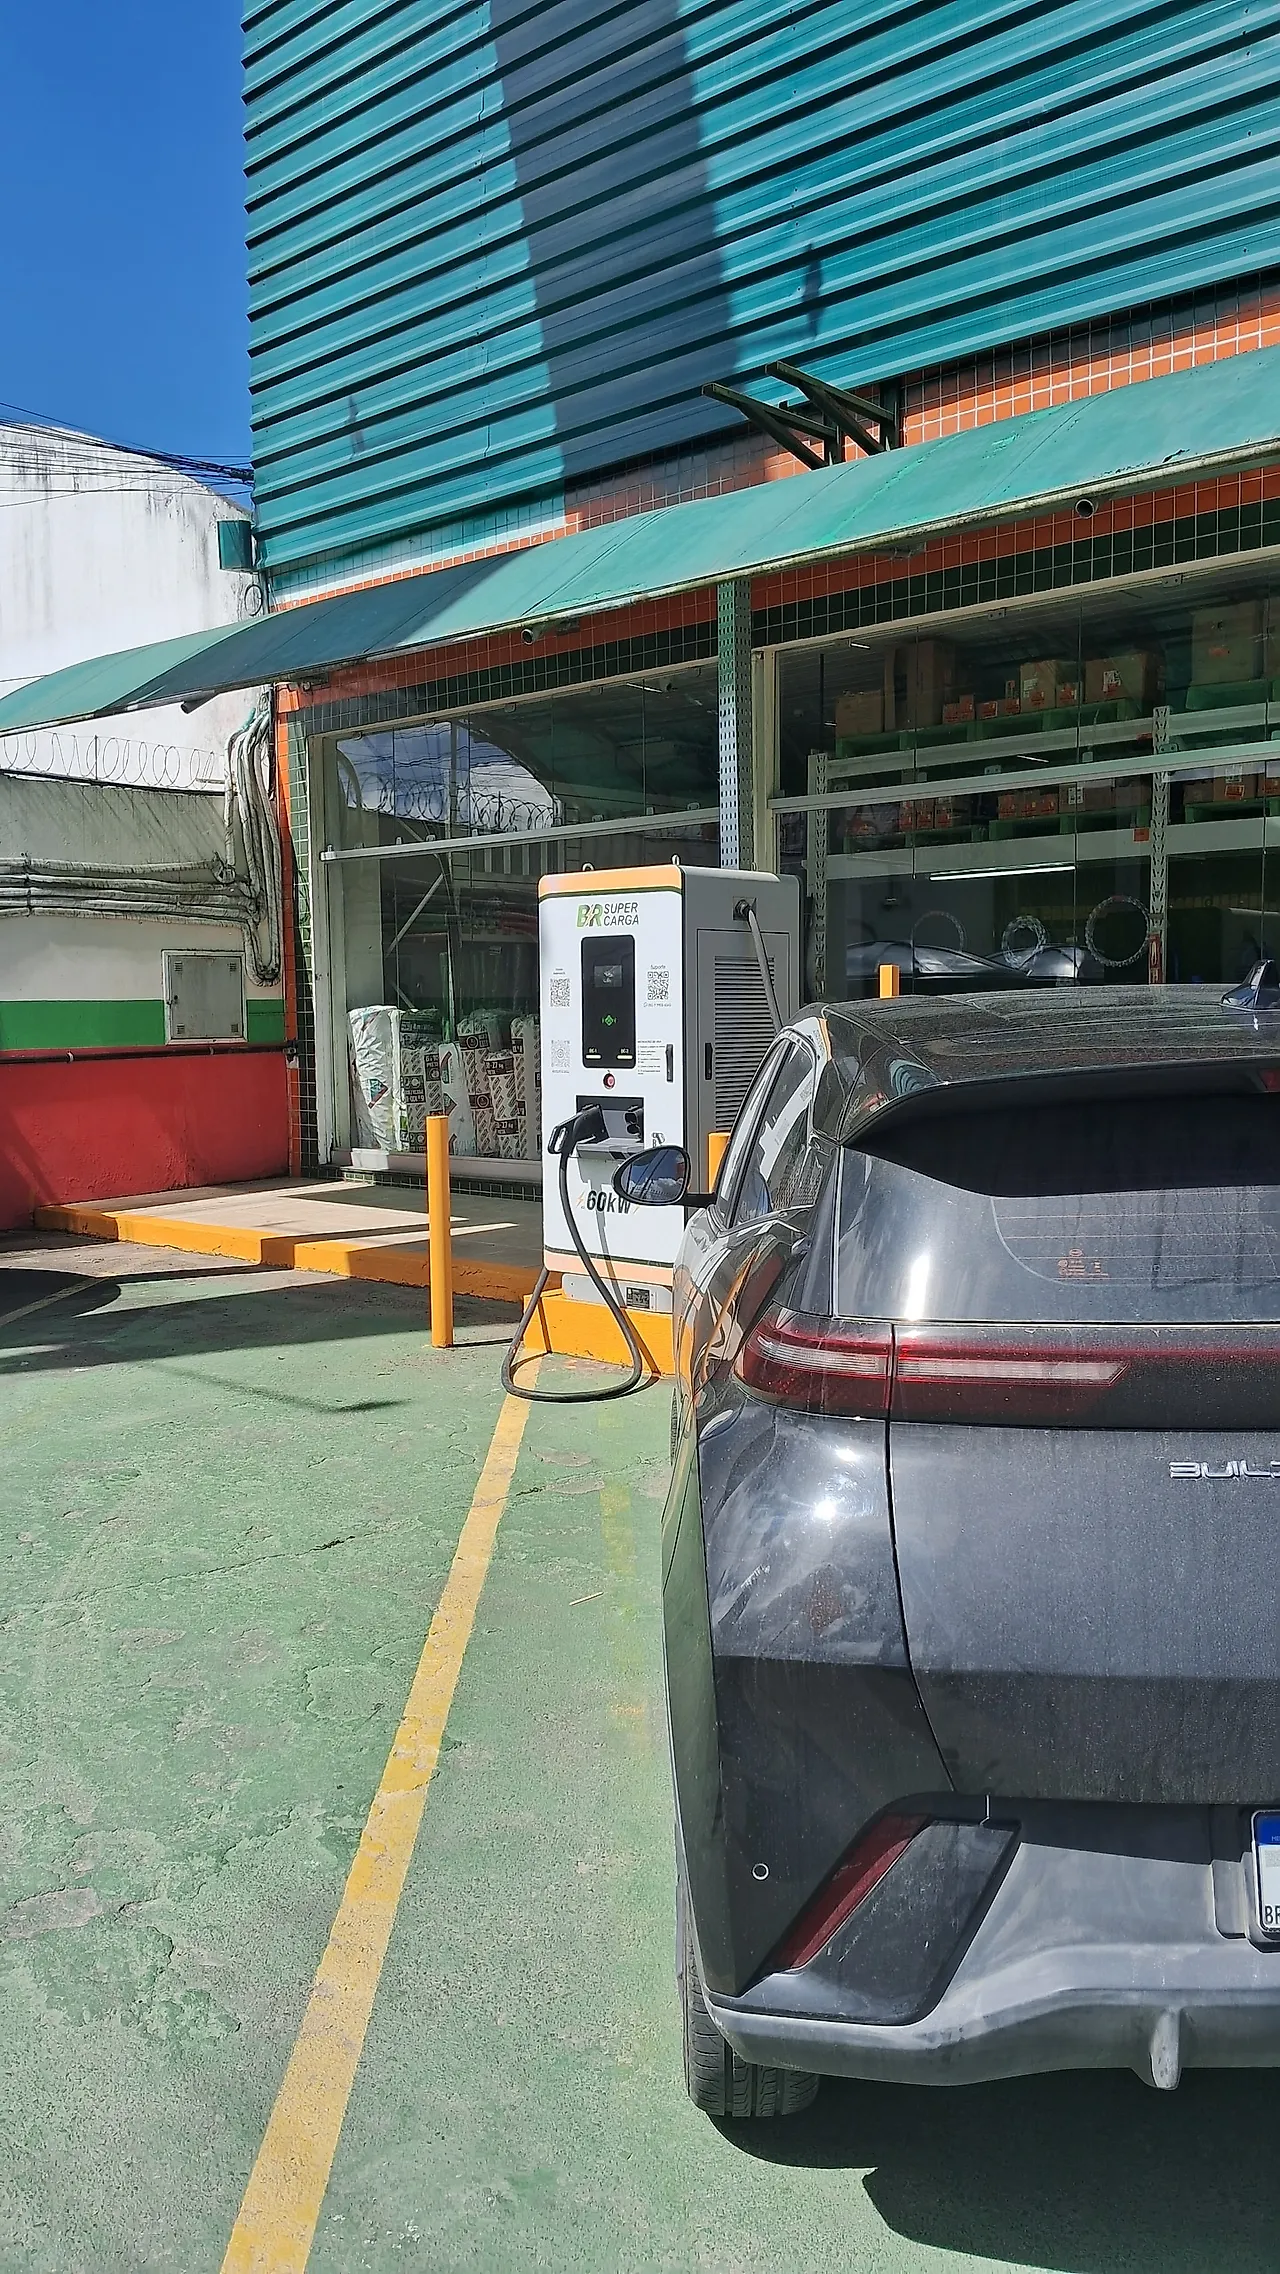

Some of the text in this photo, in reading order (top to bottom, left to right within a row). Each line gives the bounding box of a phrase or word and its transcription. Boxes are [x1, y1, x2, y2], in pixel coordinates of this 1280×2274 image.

[577, 904, 603, 927] BR
[604, 902, 638, 914] SUPER
[603, 915, 639, 926] CARGA
[587, 1190, 630, 1214] 60kW
